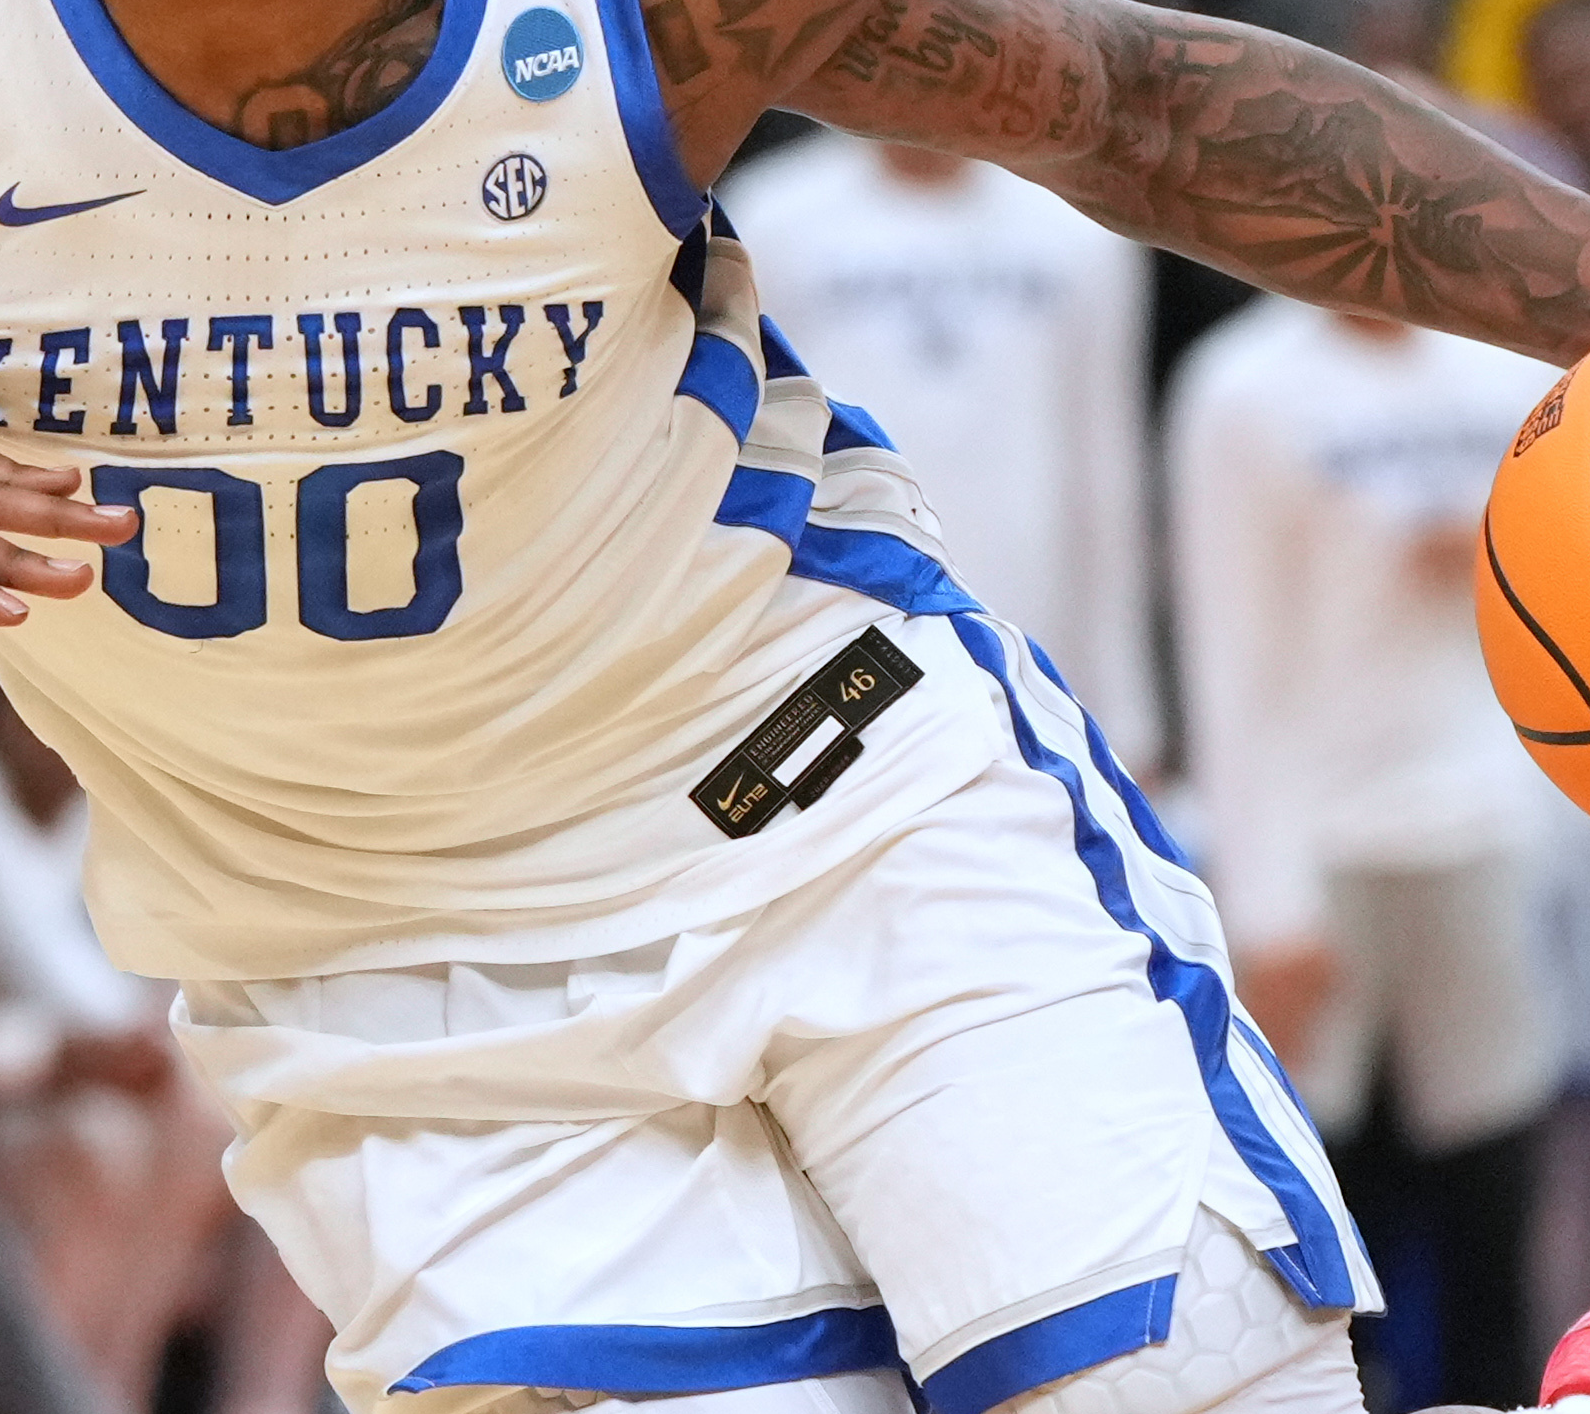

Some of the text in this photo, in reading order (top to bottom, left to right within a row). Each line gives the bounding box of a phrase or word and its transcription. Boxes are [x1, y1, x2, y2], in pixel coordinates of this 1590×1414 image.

[514, 44, 581, 84] NCAA
[885, 9, 999, 72] by
[484, 156, 545, 220] SEC
[90, 449, 465, 642] 00
[838, 667, 877, 703] 46
